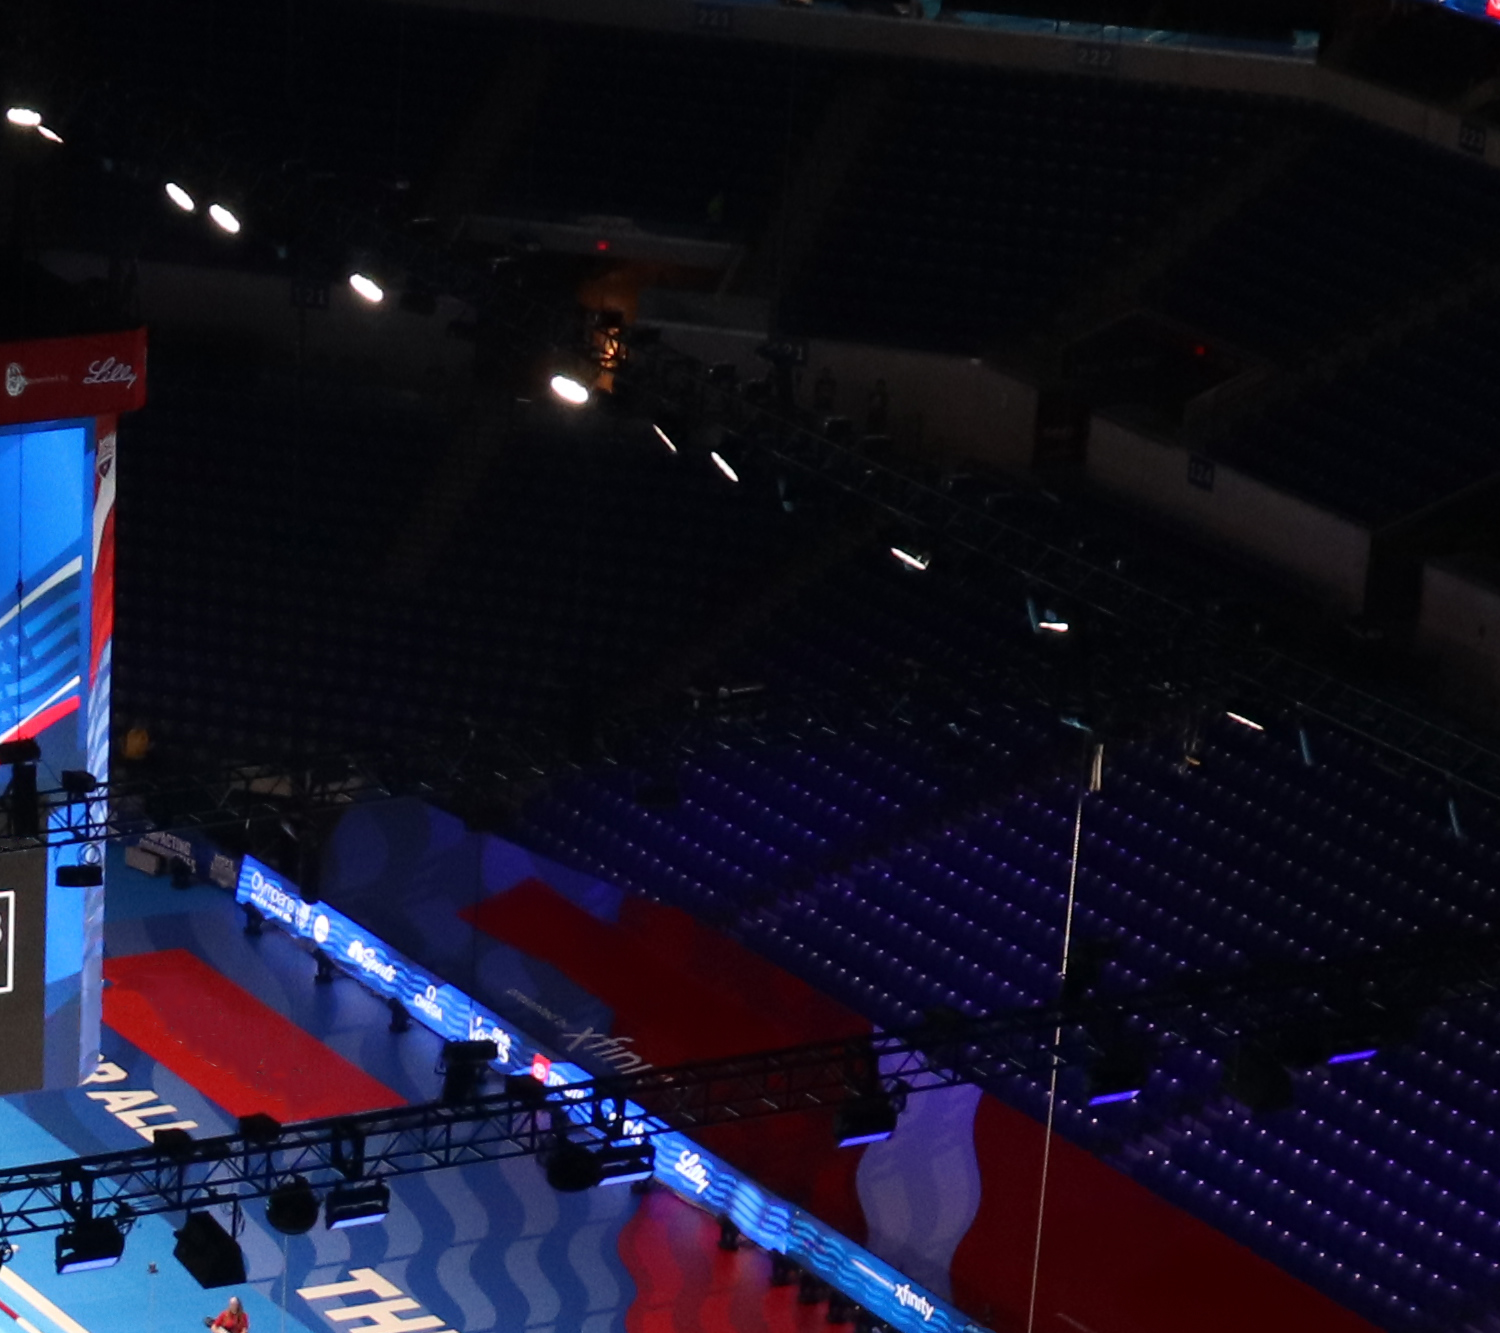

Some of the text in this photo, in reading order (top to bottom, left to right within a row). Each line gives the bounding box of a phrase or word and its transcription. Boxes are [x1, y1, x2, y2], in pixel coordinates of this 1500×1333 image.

[1079, 48, 1111, 66] 222
[82, 356, 138, 390] Lilly
[363, 948, 397, 982] Sports
[414, 994, 443, 1022] OMEGA
[469, 1016, 509, 1063] Vens
[562, 1026, 653, 1075] xfini
[85, 1088, 199, 1144] ALL
[674, 1150, 710, 1195] Lilly
[893, 1282, 935, 1322] xfinity
